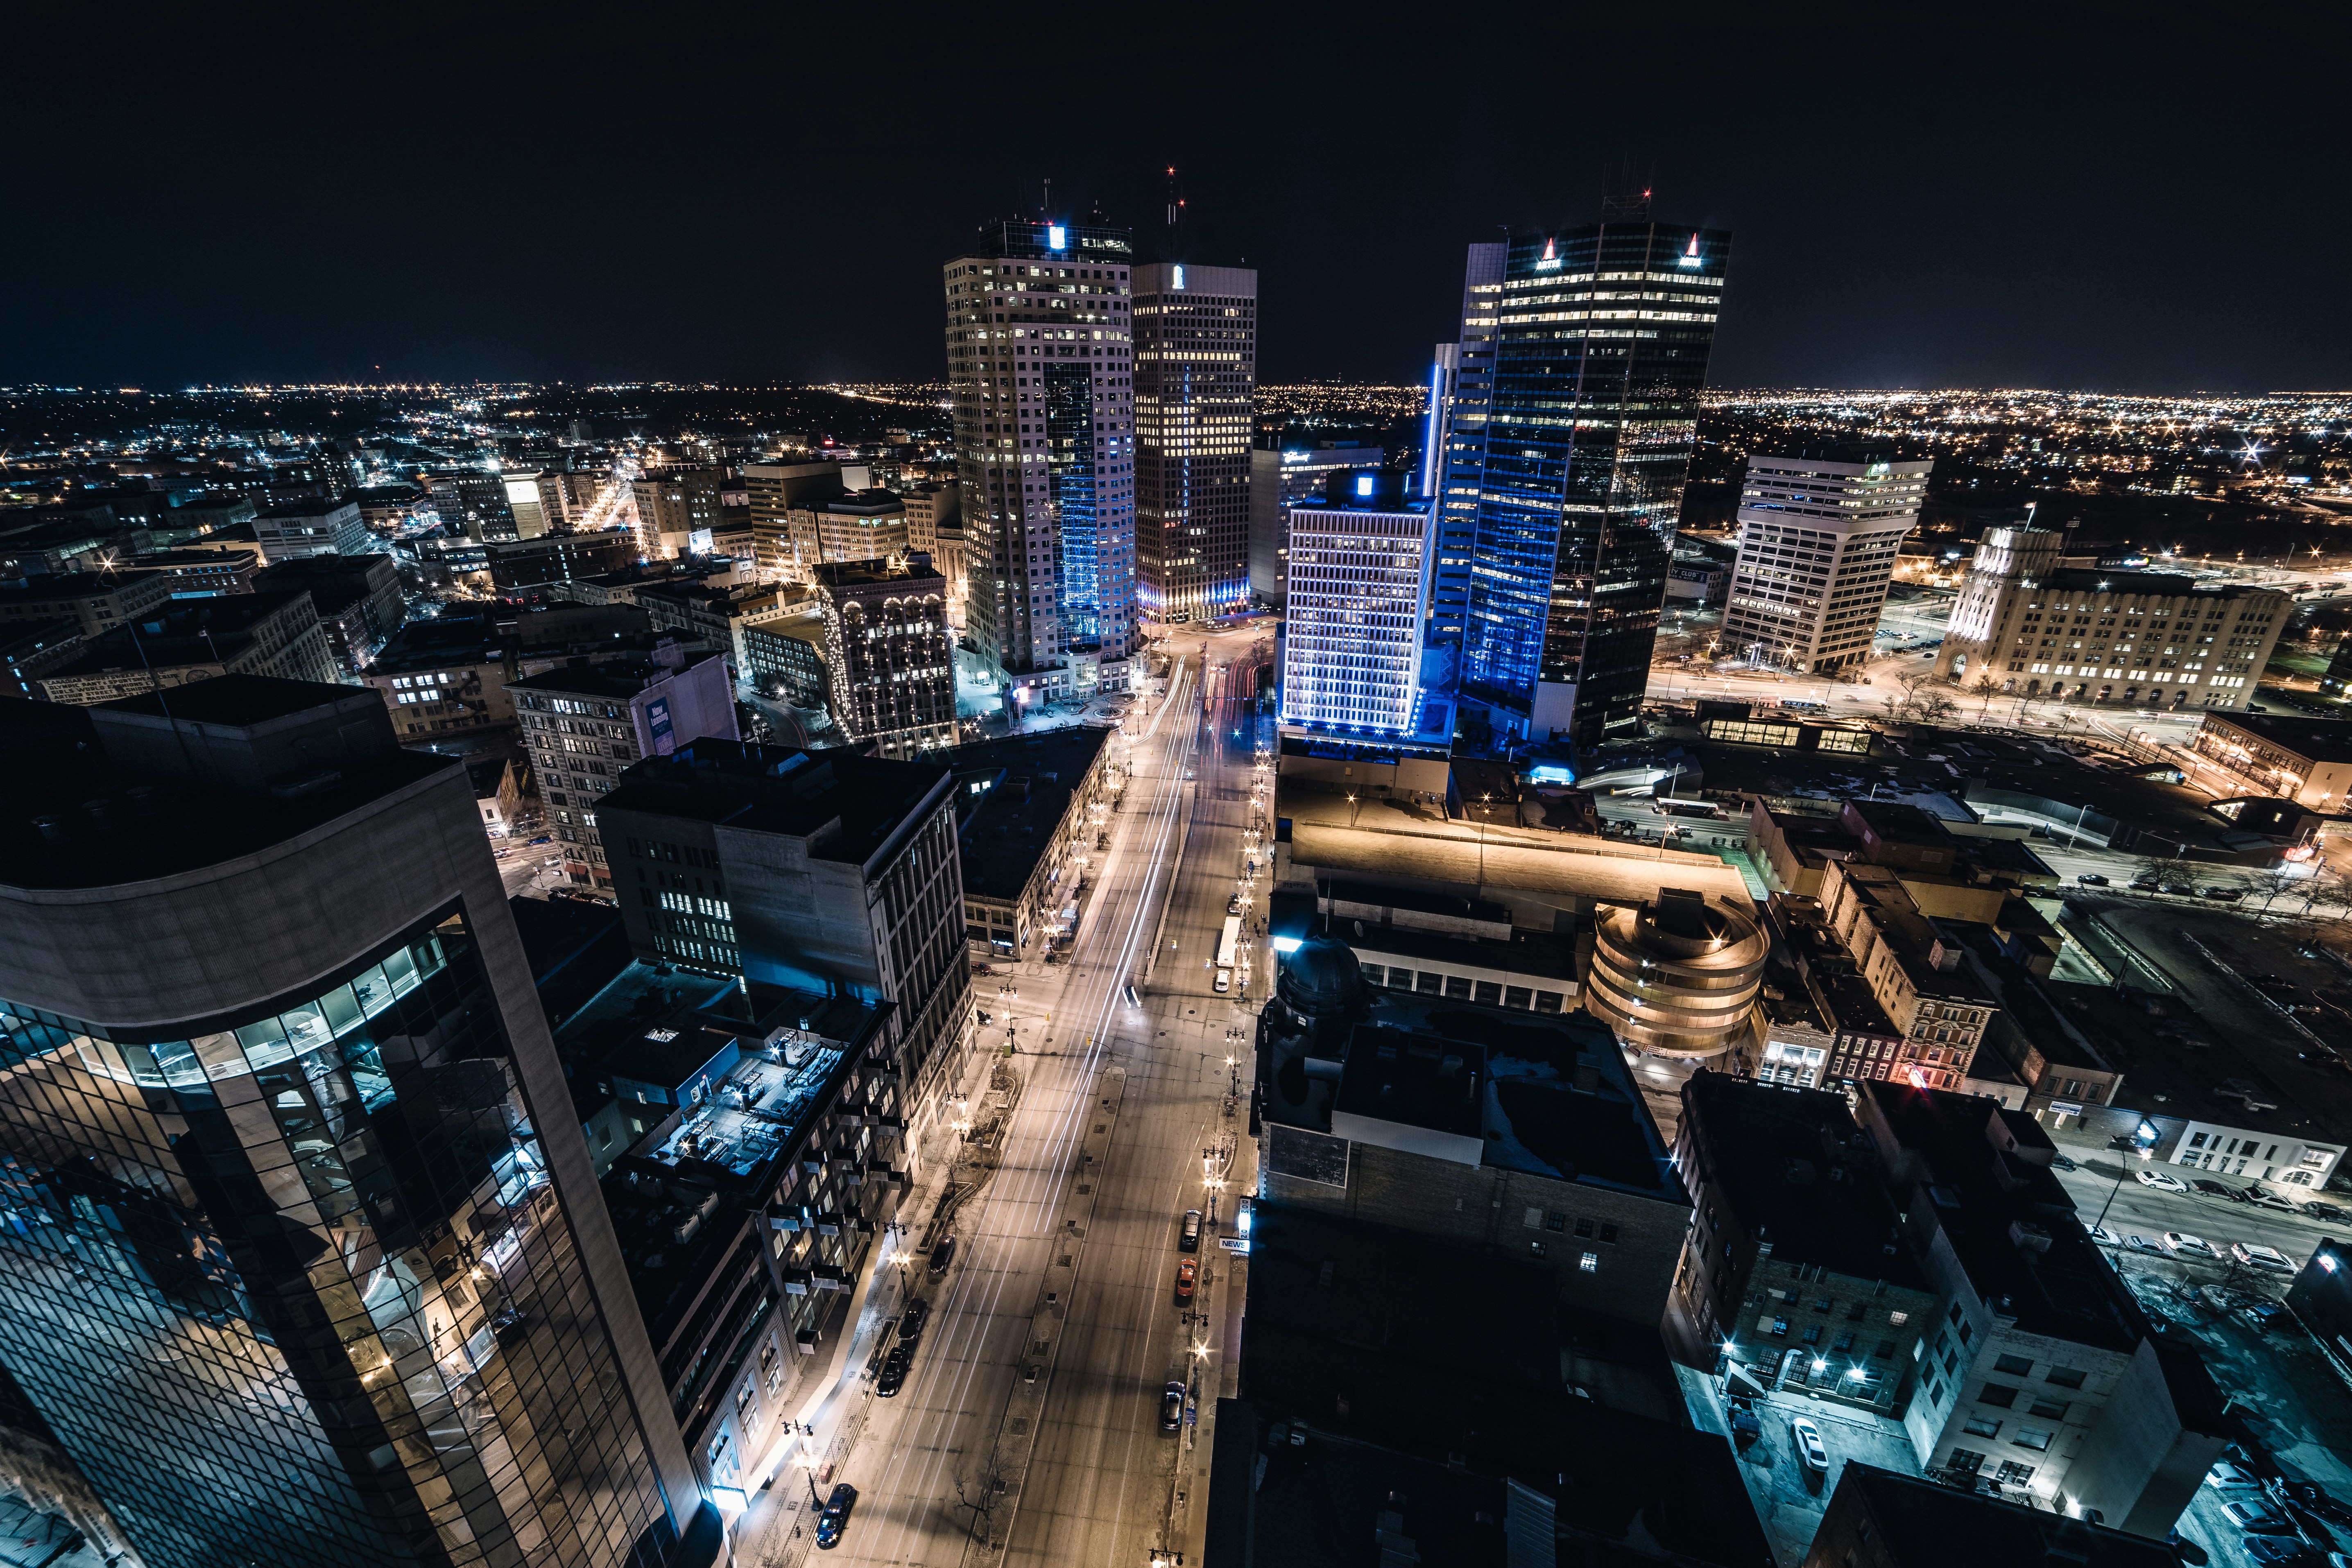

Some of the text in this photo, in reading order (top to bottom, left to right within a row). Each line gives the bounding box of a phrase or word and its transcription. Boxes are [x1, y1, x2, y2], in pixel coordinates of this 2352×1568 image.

[1536, 259, 1560, 270] ARTIS
[109, 676, 152, 685] SPORTSWEA
[652, 705, 663, 717] Now
[651, 712, 668, 727] Leasing
[1241, 1199, 1249, 1239] DOMON
[1222, 1240, 1245, 1249] NEWS
